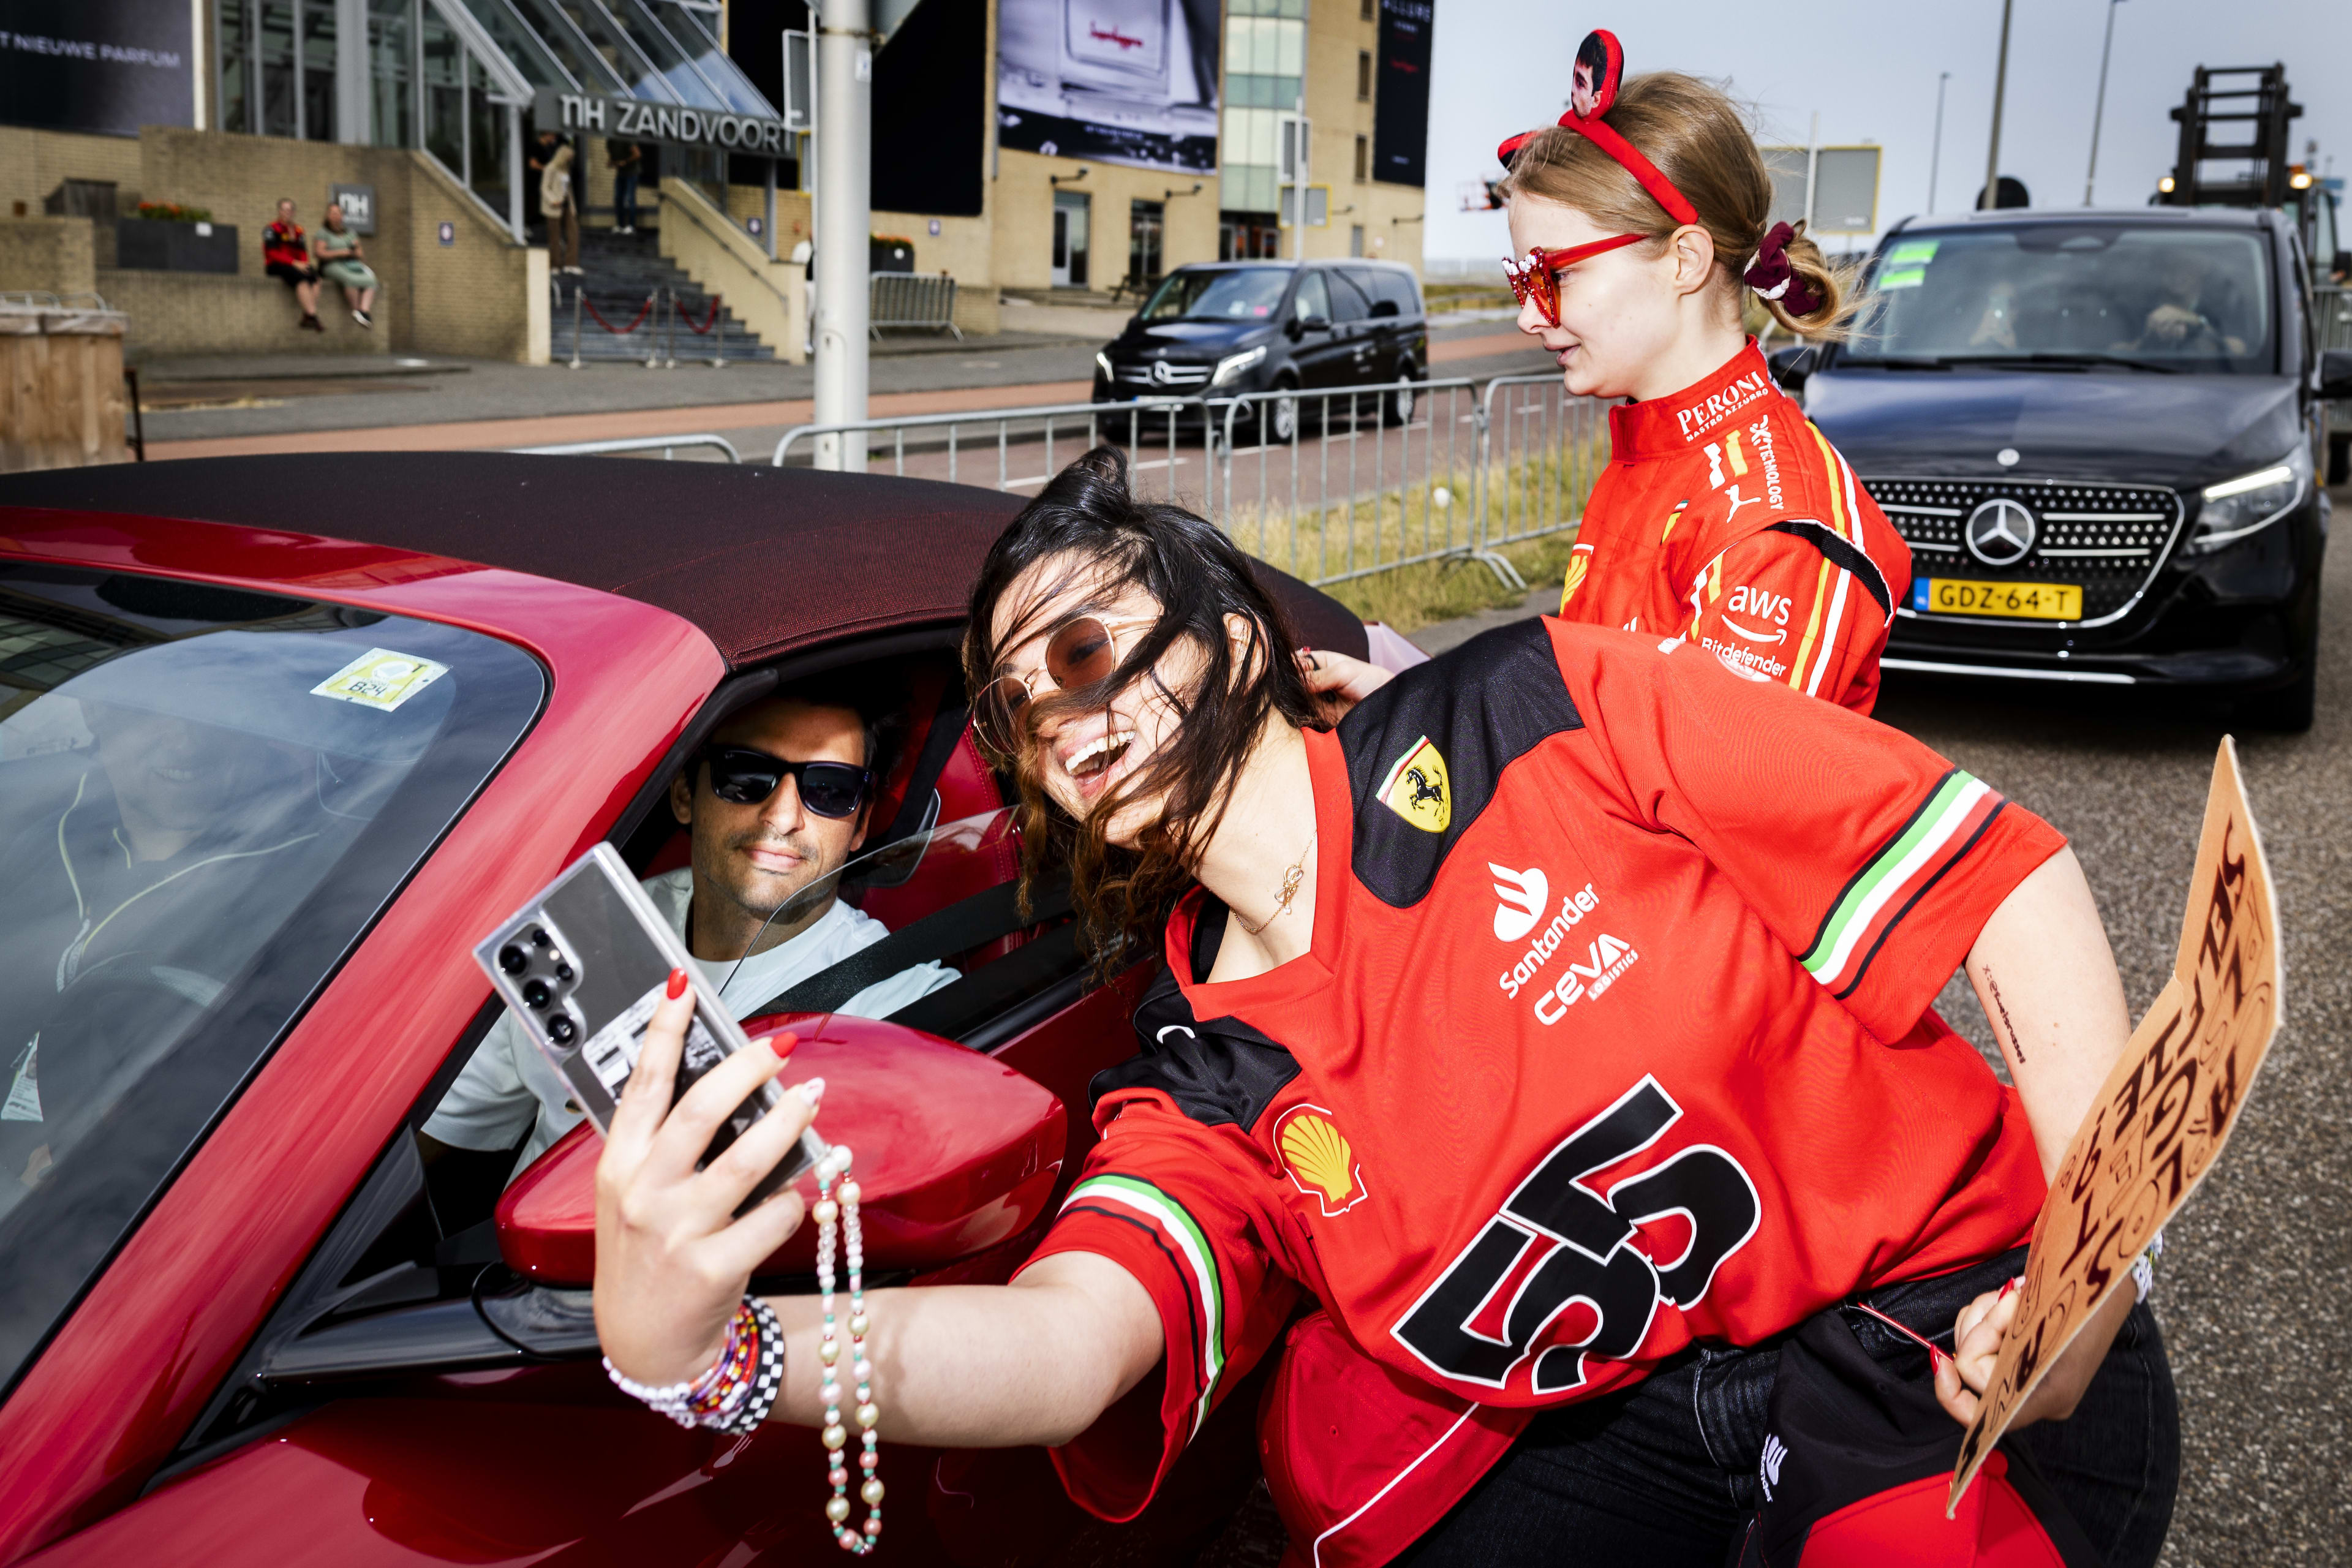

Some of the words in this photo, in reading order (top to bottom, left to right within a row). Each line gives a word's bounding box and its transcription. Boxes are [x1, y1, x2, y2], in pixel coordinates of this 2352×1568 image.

[13, 32, 97, 60] NIEUWE
[99, 43, 181, 68] PARFUM
[616, 101, 792, 153] ZANDVOORT
[1676, 371, 1765, 435] PERONI
[1686, 413, 1724, 443] NASTRO
[1725, 388, 1769, 417] AZZURRO
[1728, 586, 1792, 626] aws
[1939, 584, 2070, 612] GDZ-64-T
[1701, 636, 1787, 677] Bitdefender
[1499, 882, 1599, 1000] Santander
[1587, 949, 1639, 1000] LOGISTICS
[2059, 1057, 2198, 1278] GET
[1390, 1073, 1762, 1395] 55
